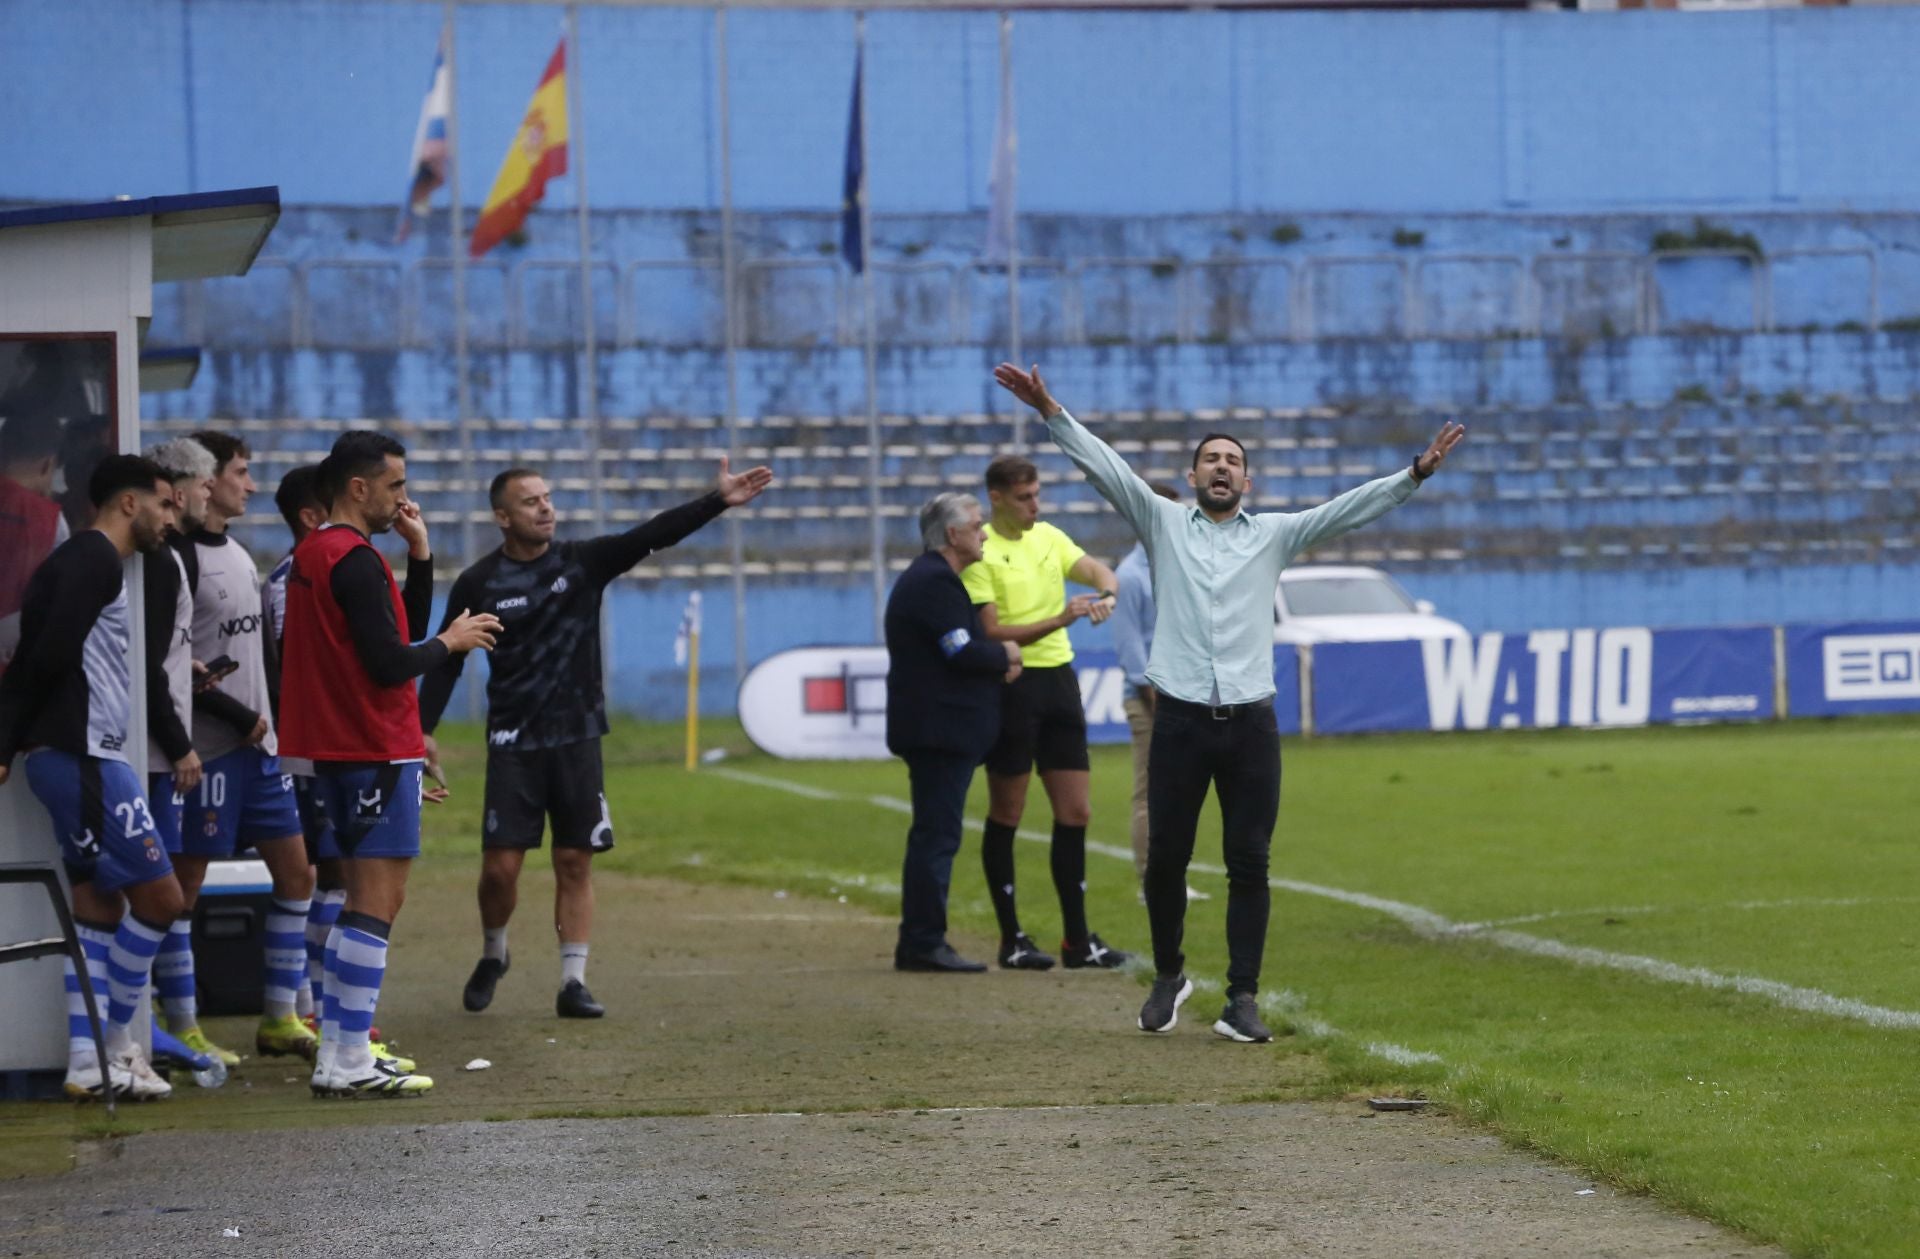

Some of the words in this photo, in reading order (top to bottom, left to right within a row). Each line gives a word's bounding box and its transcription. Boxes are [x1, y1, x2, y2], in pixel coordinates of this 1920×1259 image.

[1421, 627, 1653, 732] WATIO
[200, 771, 226, 808] 10
[115, 796, 155, 839] 23
